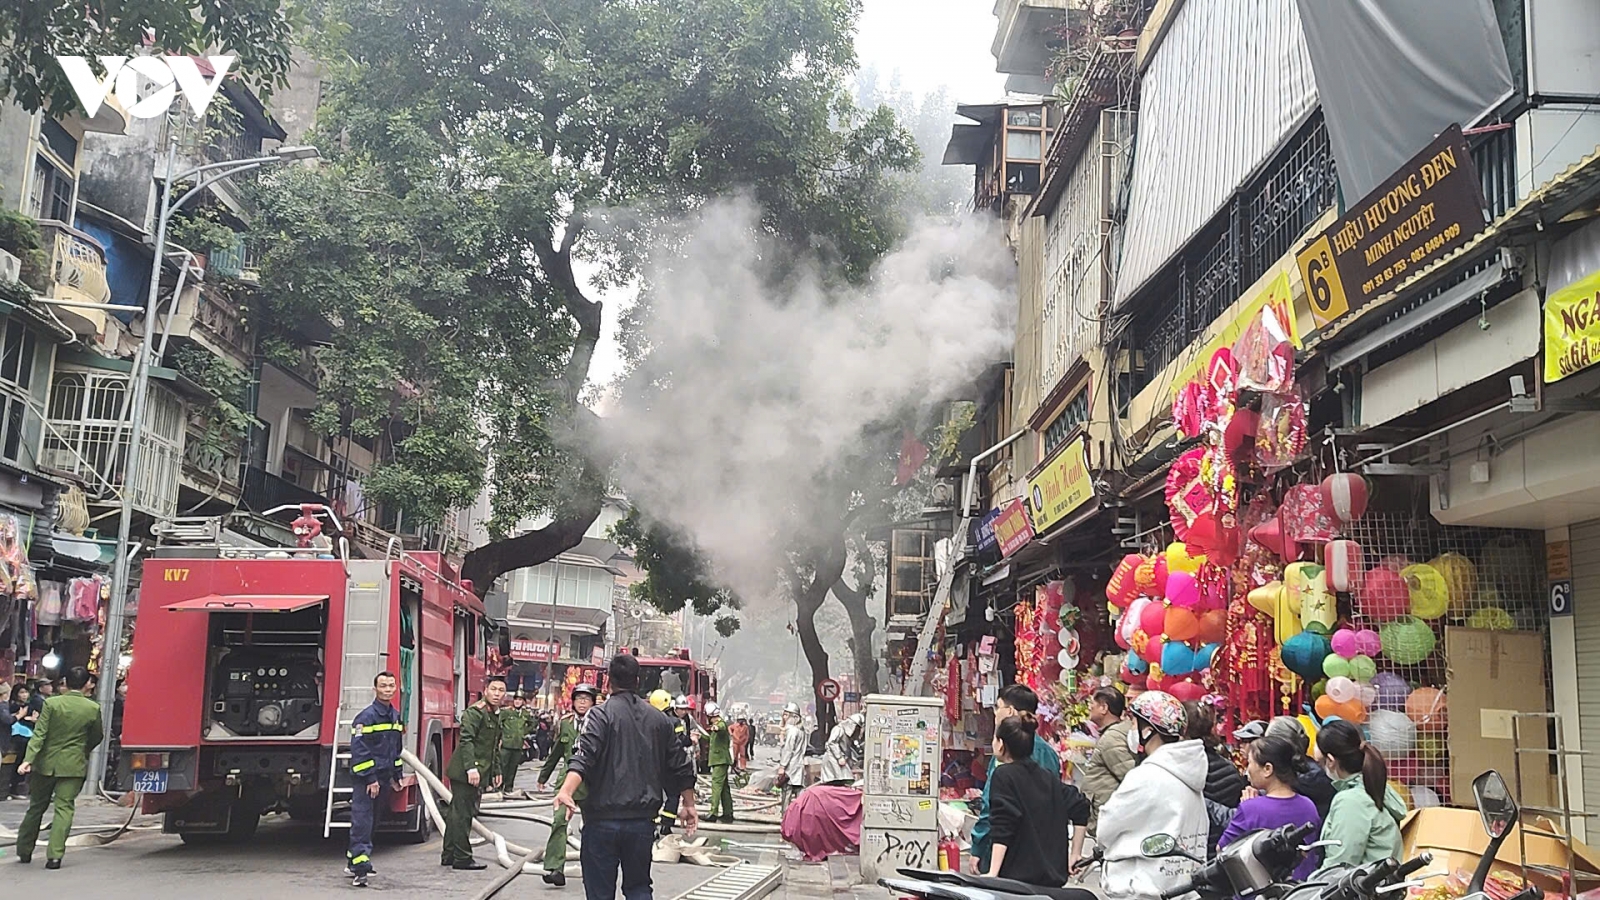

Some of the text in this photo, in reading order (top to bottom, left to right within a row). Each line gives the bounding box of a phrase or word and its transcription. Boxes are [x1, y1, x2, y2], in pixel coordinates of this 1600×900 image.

[1332, 146, 1458, 256] HIỆU HƯƠNG ĐEN
[1364, 203, 1436, 267] MINH NGUYỆT
[1362, 281, 1375, 295] 091
[1374, 273, 1384, 286] 33
[1383, 268, 1394, 281] 83
[1394, 258, 1407, 276] 753
[1424, 233, 1445, 254] 8484
[1443, 222, 1461, 242] 909
[164, 568, 190, 581] KV7
[1551, 583, 1571, 612] 6B
[142, 771, 159, 781] 29A
